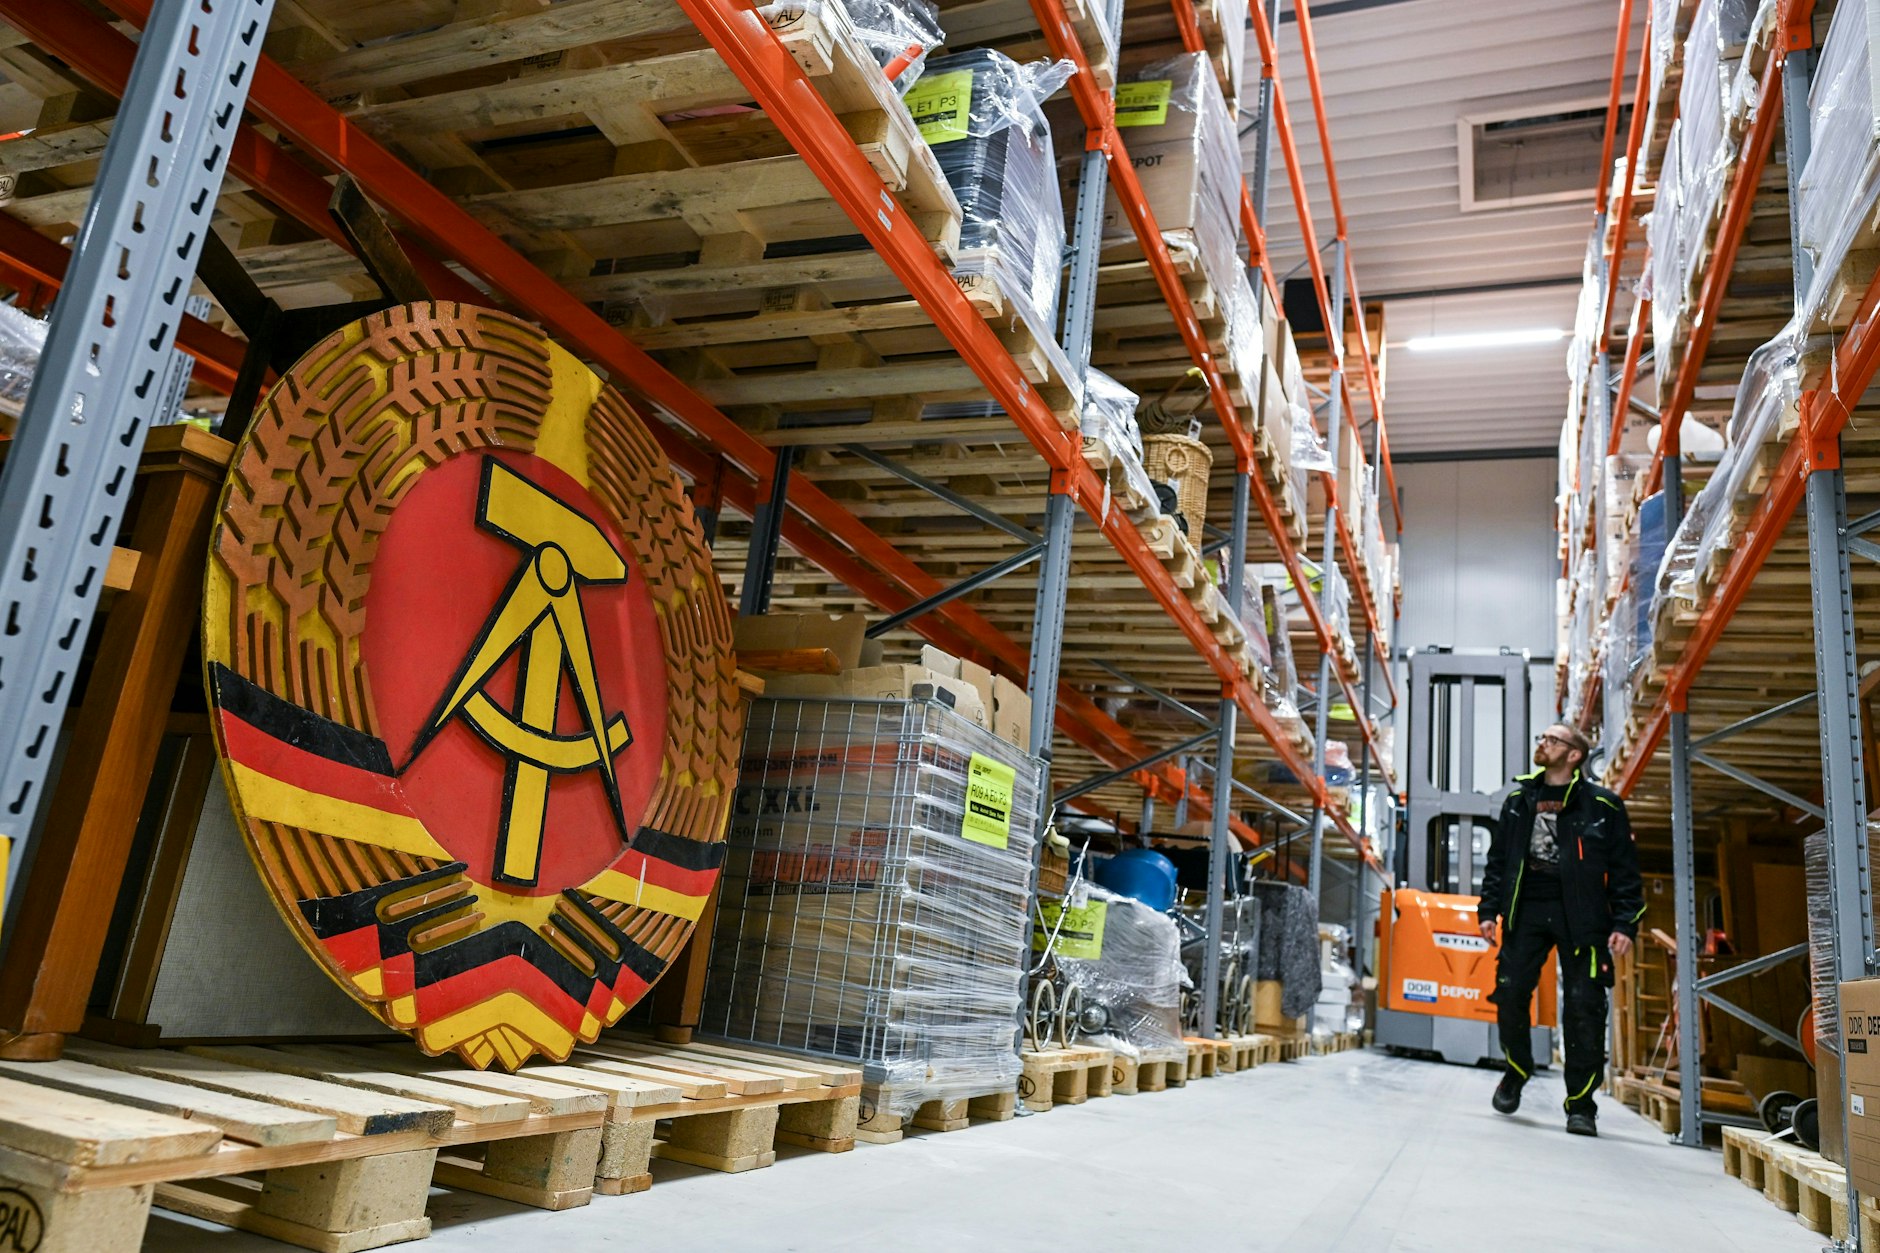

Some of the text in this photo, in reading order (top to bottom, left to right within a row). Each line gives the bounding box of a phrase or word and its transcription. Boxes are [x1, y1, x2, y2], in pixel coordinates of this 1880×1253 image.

[917, 101, 932, 112] E1
[940, 96, 957, 107] P3
[957, 275, 975, 288] PAL
[763, 785, 820, 814] XXL
[971, 784, 984, 798] R09
[984, 788, 989, 801] A
[1439, 936, 1483, 947] STILL
[1407, 982, 1432, 993] DDR
[1441, 986, 1480, 1000] DEPOT
[1848, 1016, 1864, 1035] DDR
